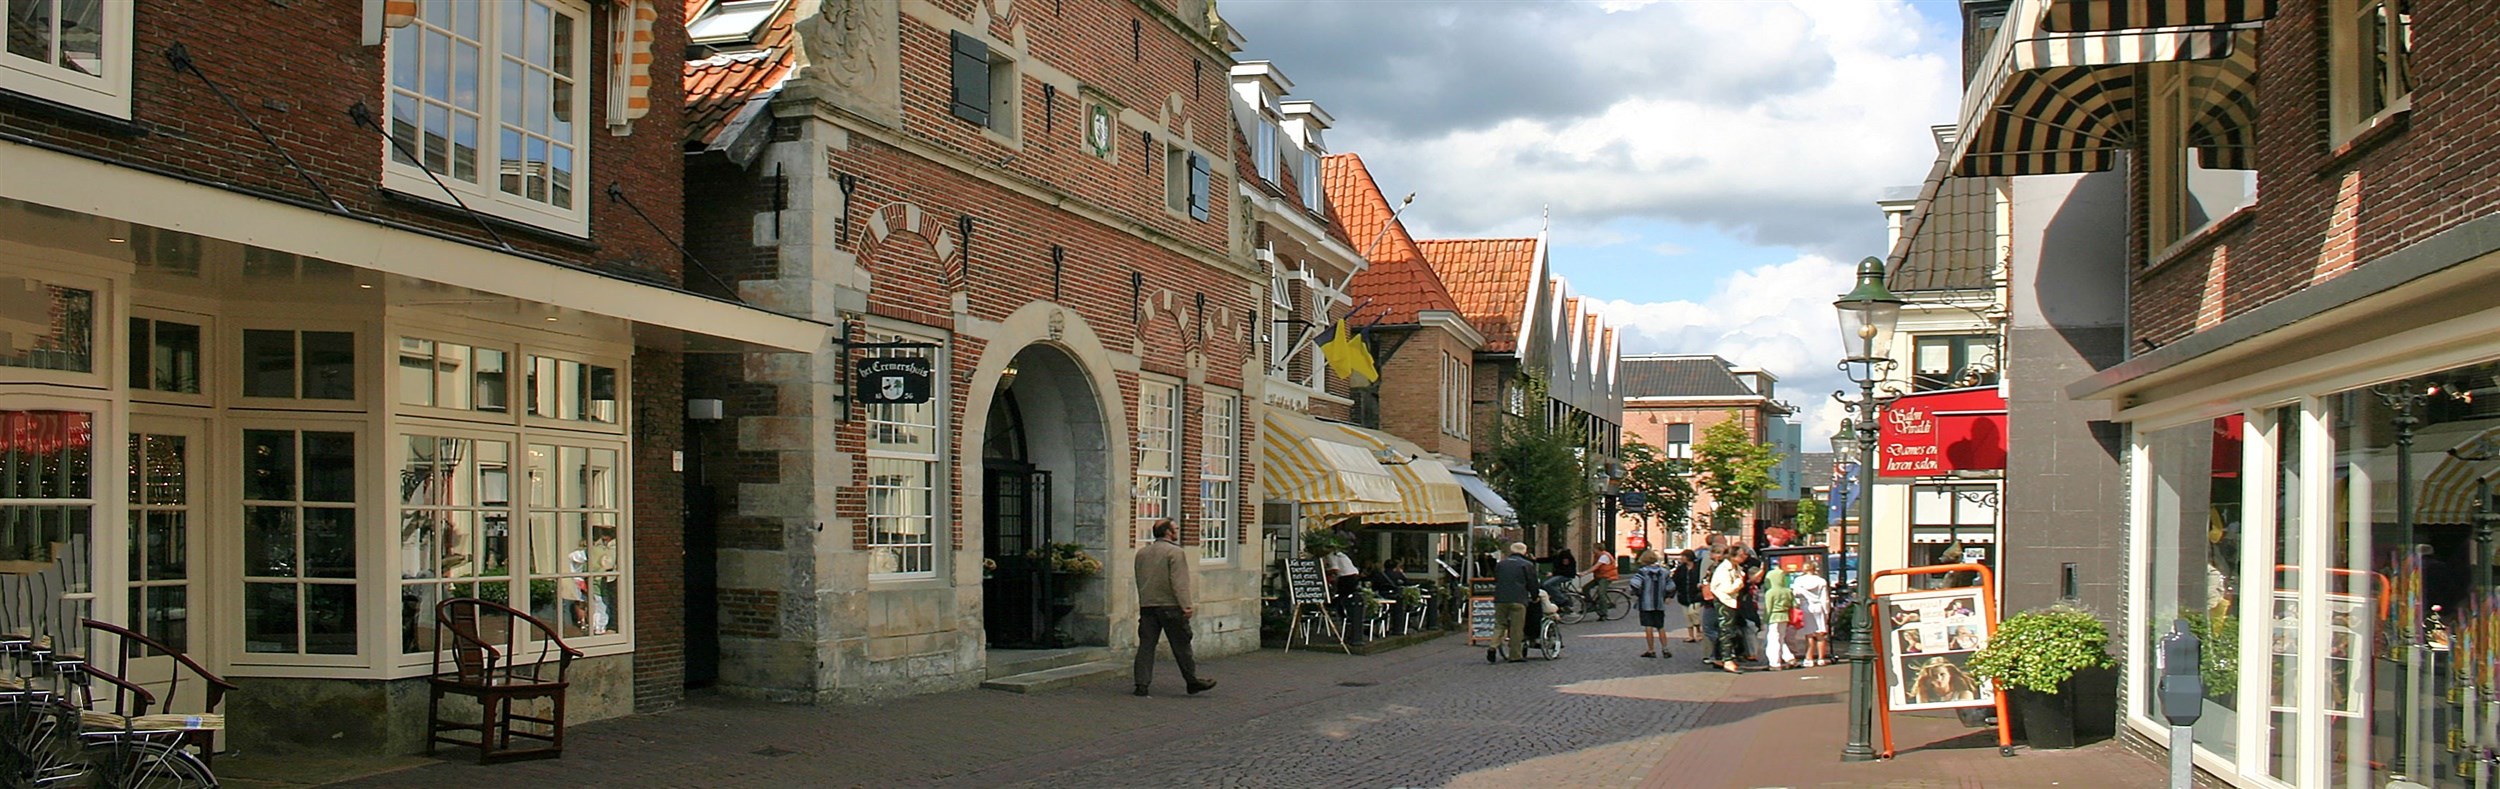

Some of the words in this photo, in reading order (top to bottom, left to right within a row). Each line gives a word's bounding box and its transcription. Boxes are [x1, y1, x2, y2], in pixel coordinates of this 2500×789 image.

[872, 361, 929, 377] Cremershuis
[1889, 407, 1923, 424] Salon
[1886, 443, 1925, 456] Dames
[1926, 446, 1938, 455] en
[1887, 458, 1913, 470] heren
[1913, 457, 1938, 470] salon
